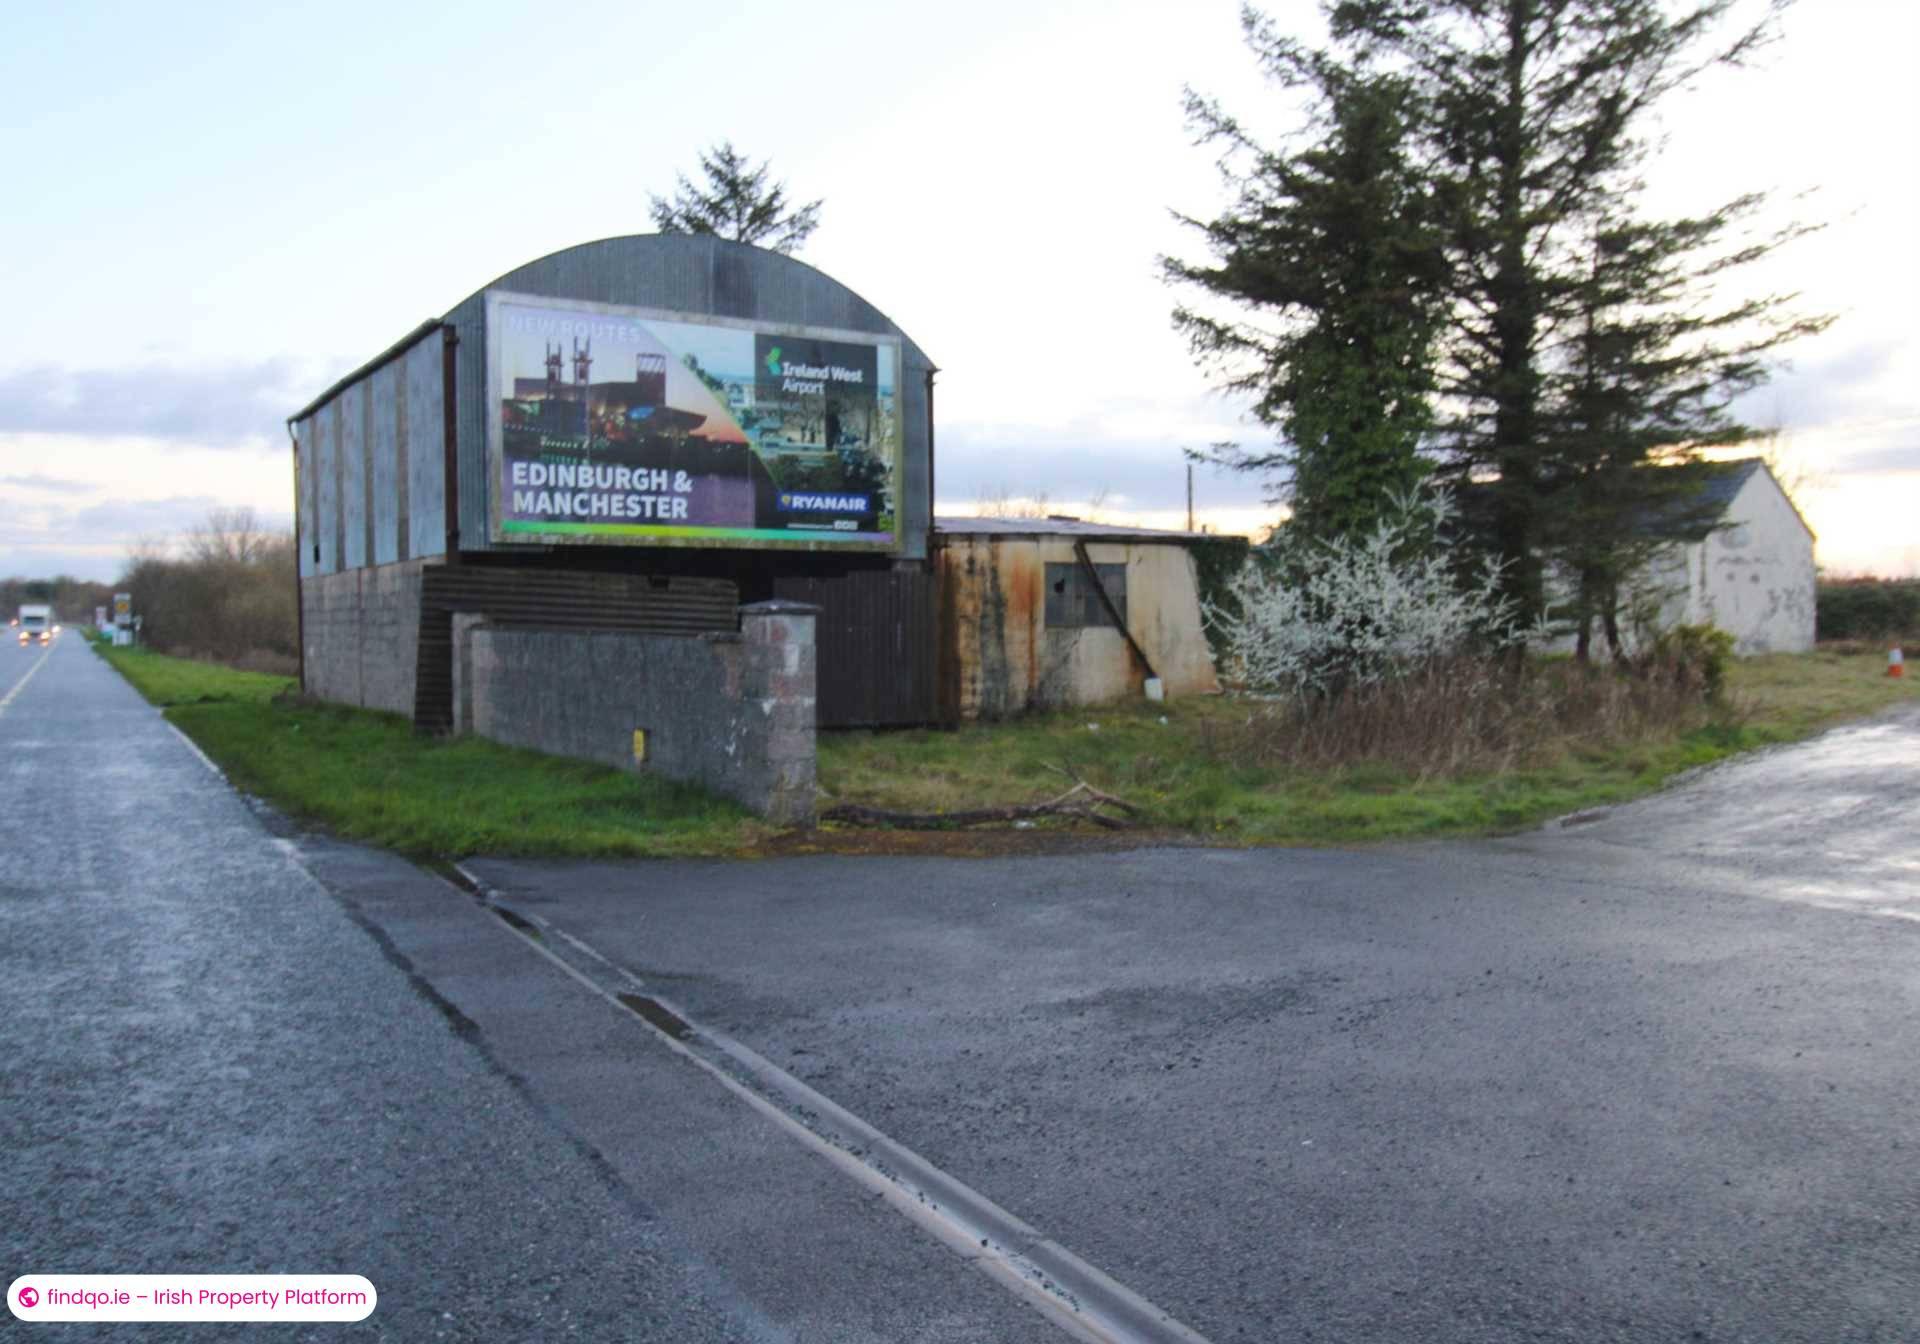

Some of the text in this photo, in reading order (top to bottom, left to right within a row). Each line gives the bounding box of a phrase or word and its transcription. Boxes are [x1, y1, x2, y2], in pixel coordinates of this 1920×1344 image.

[511, 315, 640, 344] NEW ROUTES
[783, 362, 863, 383] Ireland West
[782, 378, 824, 395] Airport
[512, 461, 693, 493] EDINBURGH &
[513, 490, 688, 519] MANCHESTER
[792, 496, 867, 511] RYANAIR
